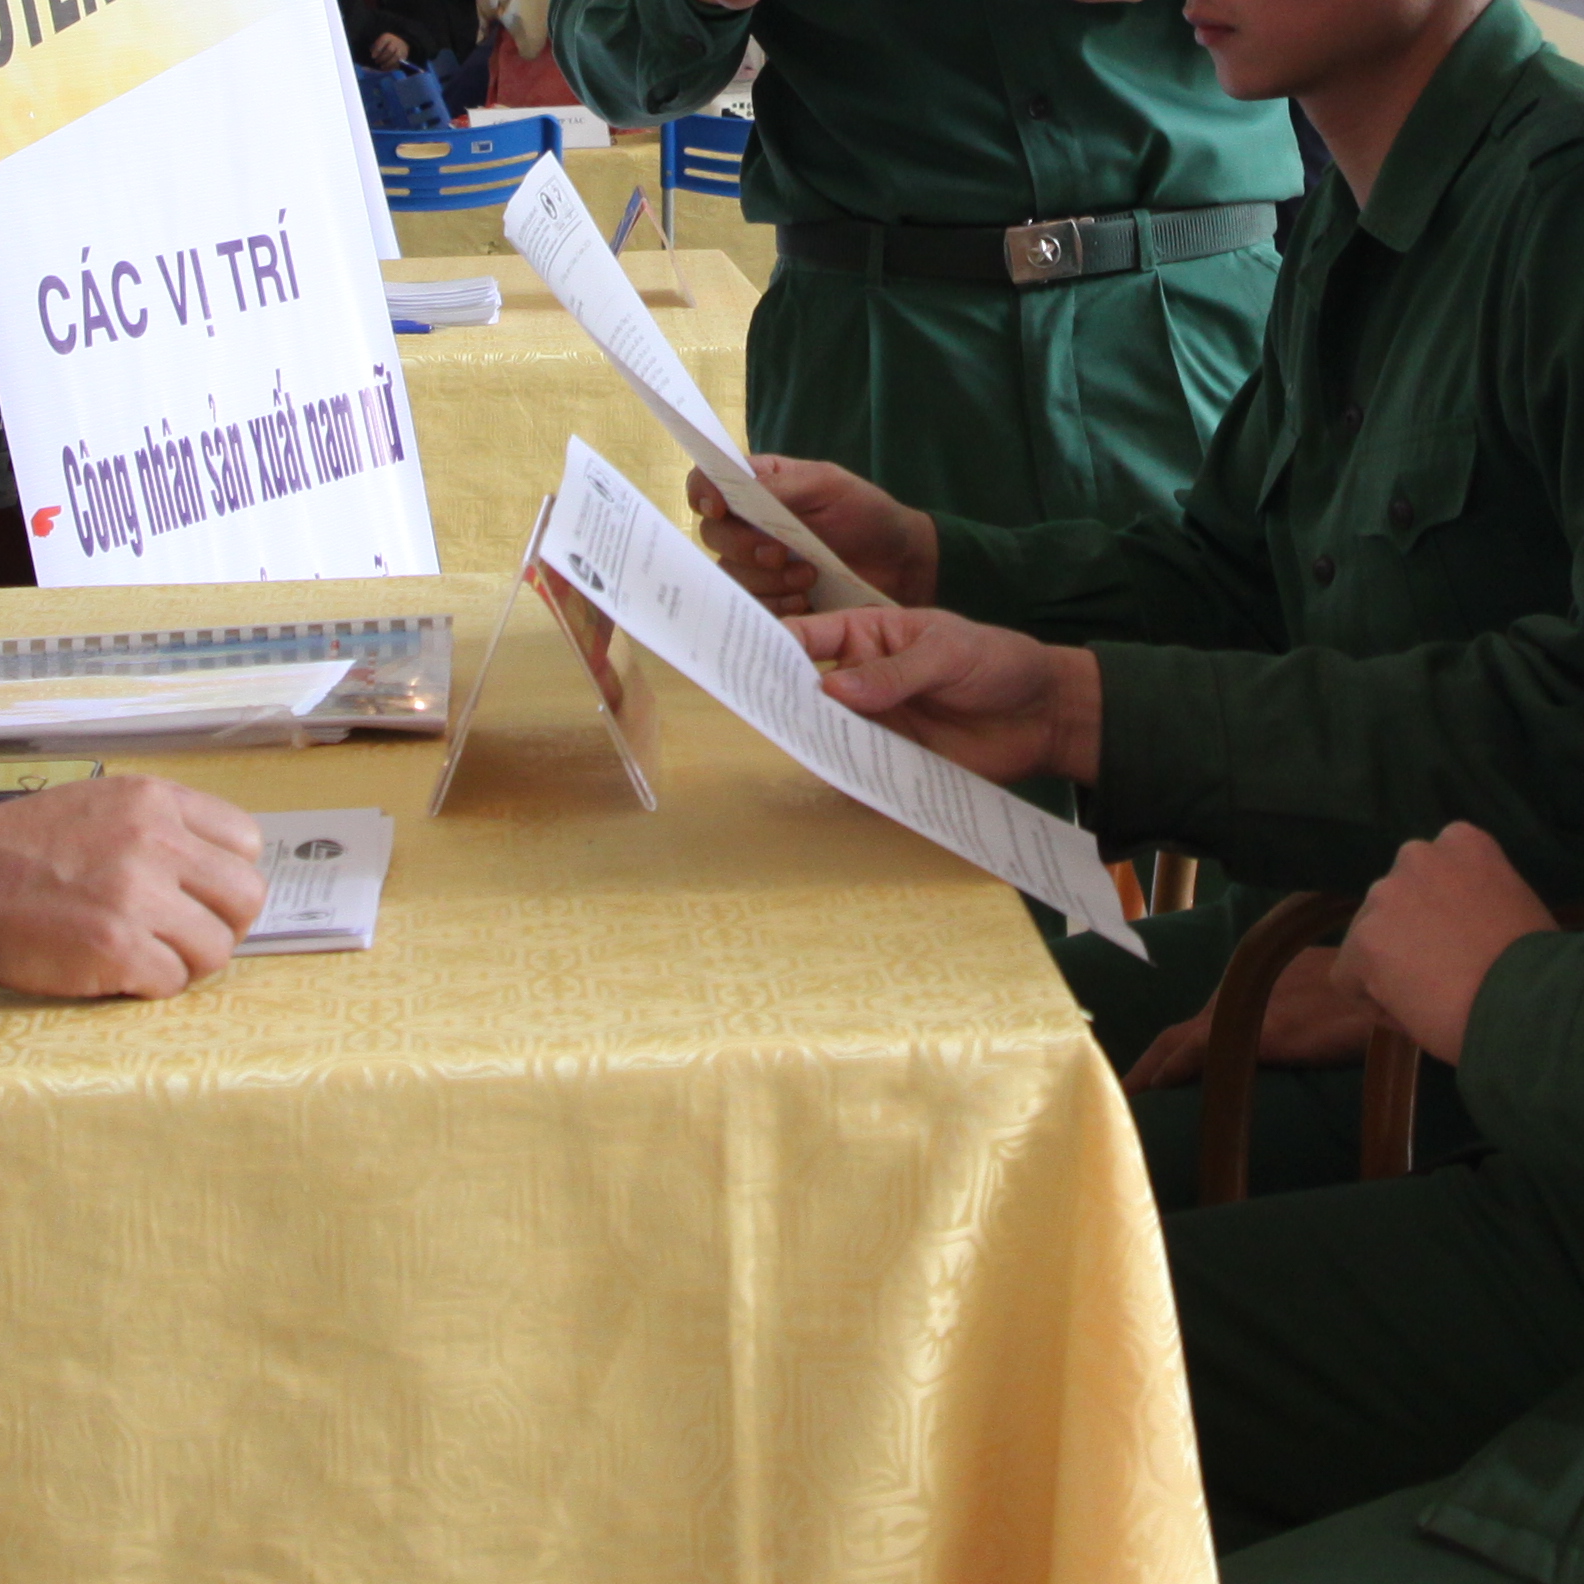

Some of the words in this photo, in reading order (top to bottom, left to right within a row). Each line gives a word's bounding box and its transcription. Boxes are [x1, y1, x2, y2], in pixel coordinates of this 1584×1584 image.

[38, 246, 150, 355] CÁC
[155, 248, 216, 338] VỊ
[215, 208, 301, 313] TRÍ
[62, 439, 143, 558] Công
[134, 417, 207, 537] nhân
[200, 393, 255, 517] sản
[247, 368, 312, 503] xuất
[303, 392, 365, 485] nam
